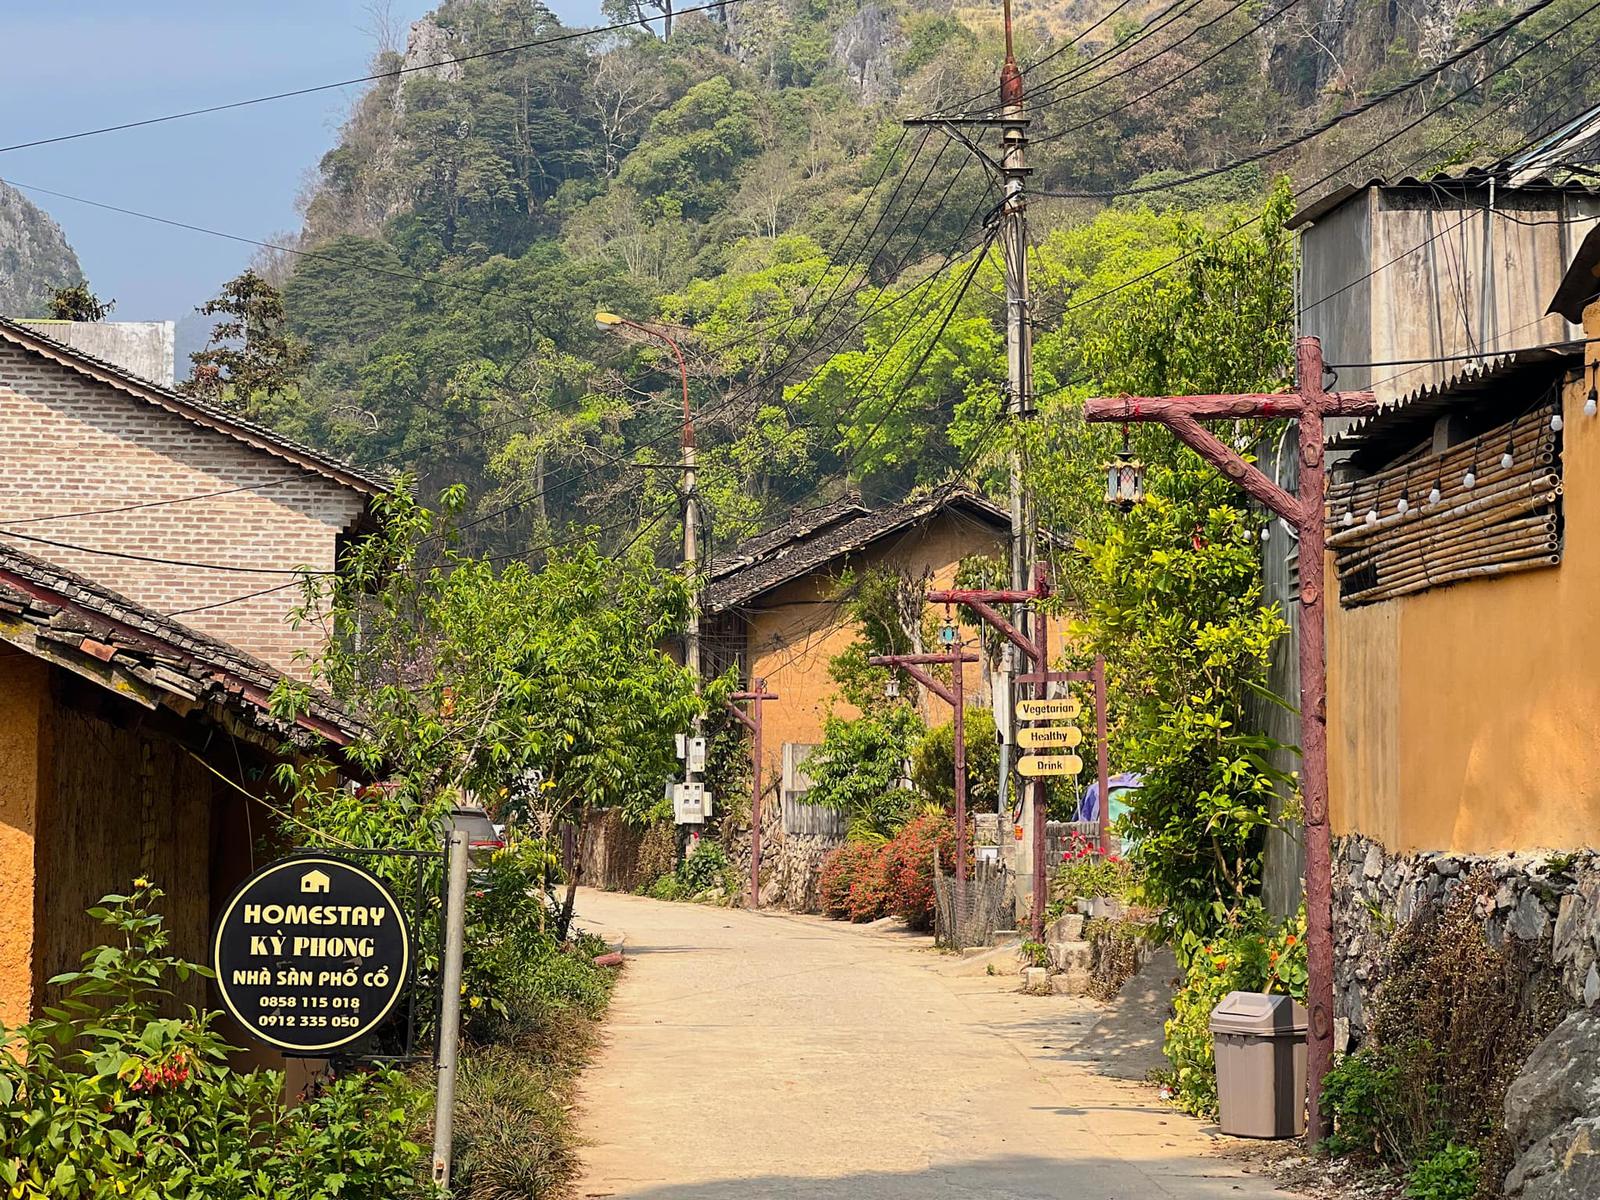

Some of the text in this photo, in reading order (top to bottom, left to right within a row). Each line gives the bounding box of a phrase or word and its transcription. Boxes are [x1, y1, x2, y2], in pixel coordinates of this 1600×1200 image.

[1023, 703, 1074, 715] Vegetarian
[1031, 731, 1068, 742] Healthy
[1037, 761, 1063, 770] Drink
[243, 904, 386, 926] HOMESTAY
[249, 929, 375, 957] KỲ PHONG
[233, 965, 390, 988] NHÀ SÀN PHỐ CỔ
[259, 996, 360, 1008] 0858 115 018
[258, 1015, 360, 1027] 0912 335 050
